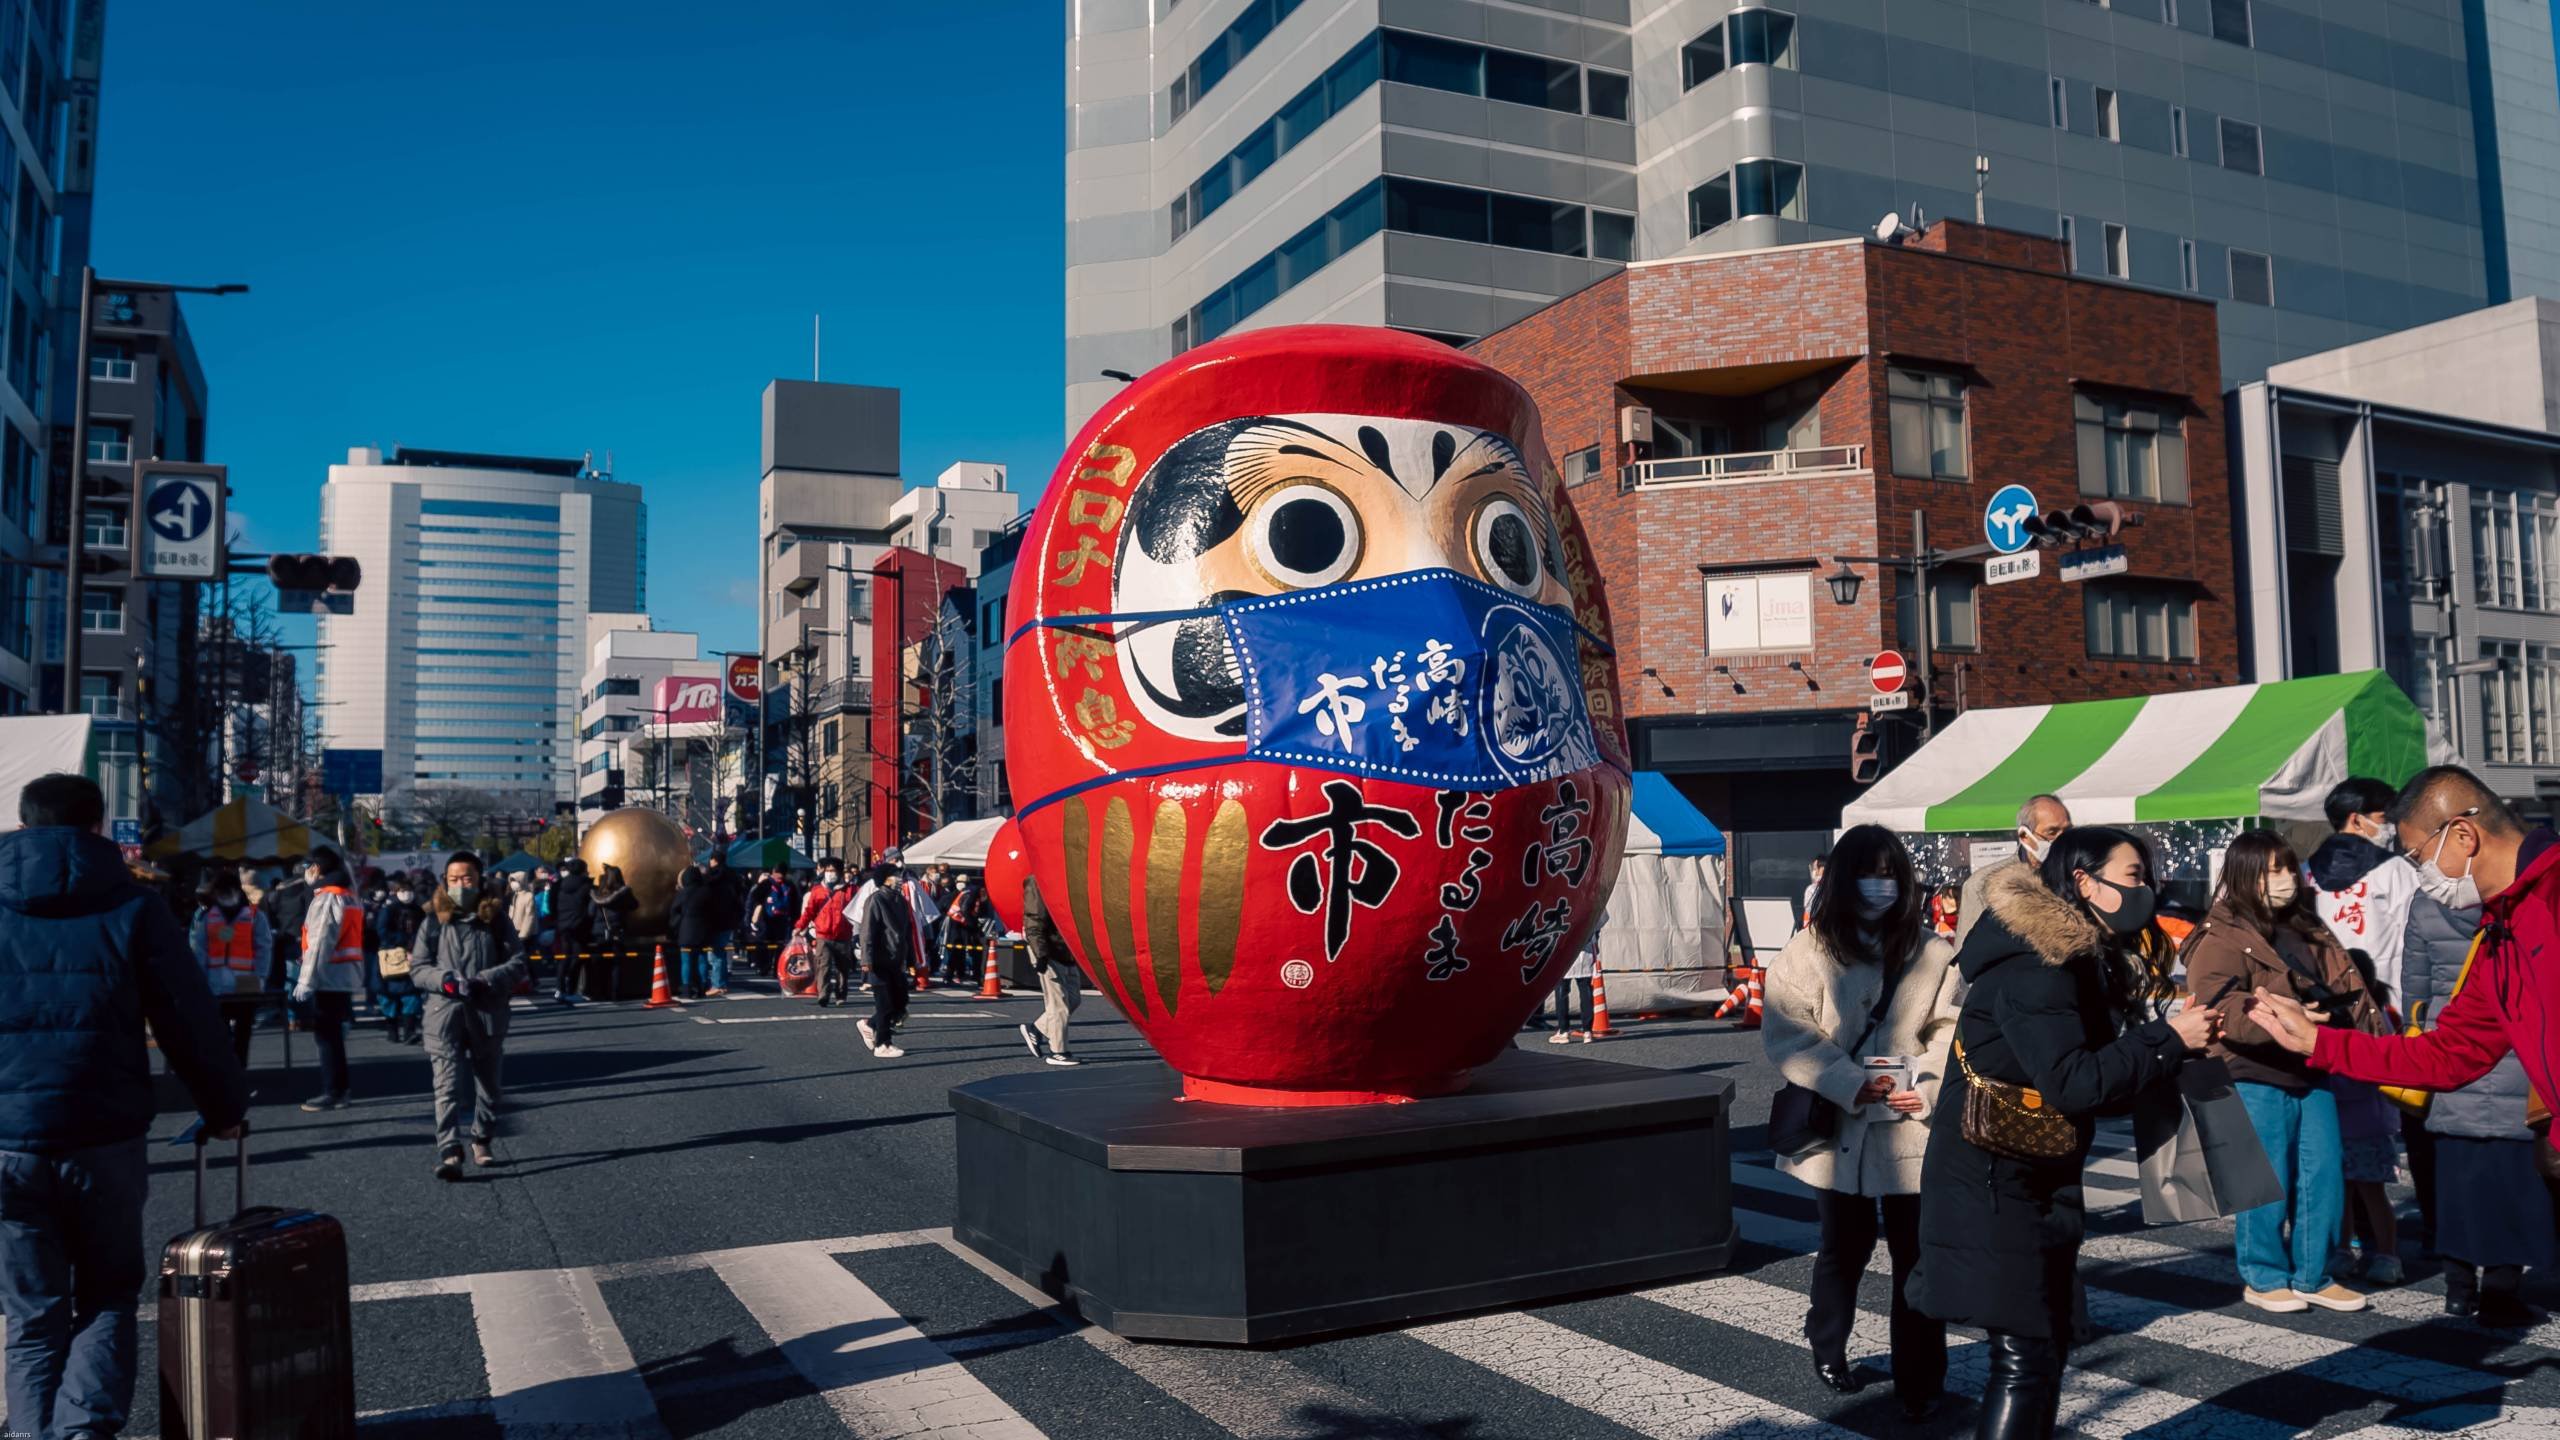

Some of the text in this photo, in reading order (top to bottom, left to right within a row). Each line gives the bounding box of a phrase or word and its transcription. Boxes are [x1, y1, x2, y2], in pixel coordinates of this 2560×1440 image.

[1989, 558, 2037, 578] 自転車を除く
[669, 682, 718, 712] JTB
[1297, 672, 1369, 753] 市
[1370, 650, 1420, 752] だるま
[1415, 638, 1469, 737] 高崎
[1259, 779, 1423, 963] 市
[1424, 789, 1498, 981] だるま
[1501, 779, 1594, 985] 高崎
